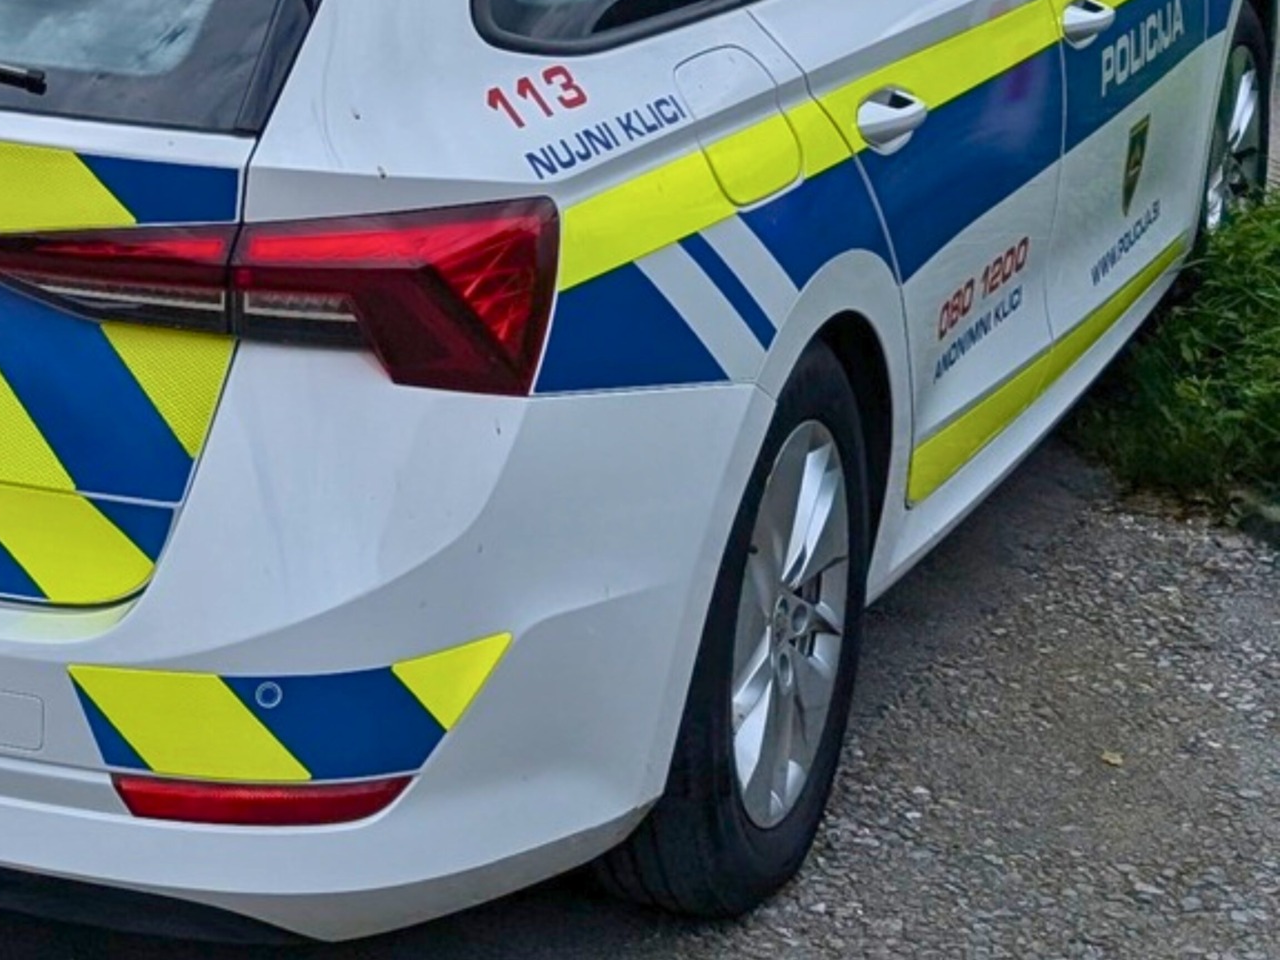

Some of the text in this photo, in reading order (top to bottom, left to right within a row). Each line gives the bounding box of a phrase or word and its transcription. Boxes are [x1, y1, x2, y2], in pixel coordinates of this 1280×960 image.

[487, 65, 588, 129] 113
[525, 95, 687, 180] NUJNI KLICI
[933, 284, 1023, 385] ANONIMNI KLICI
[938, 236, 1030, 341] 080 1200
